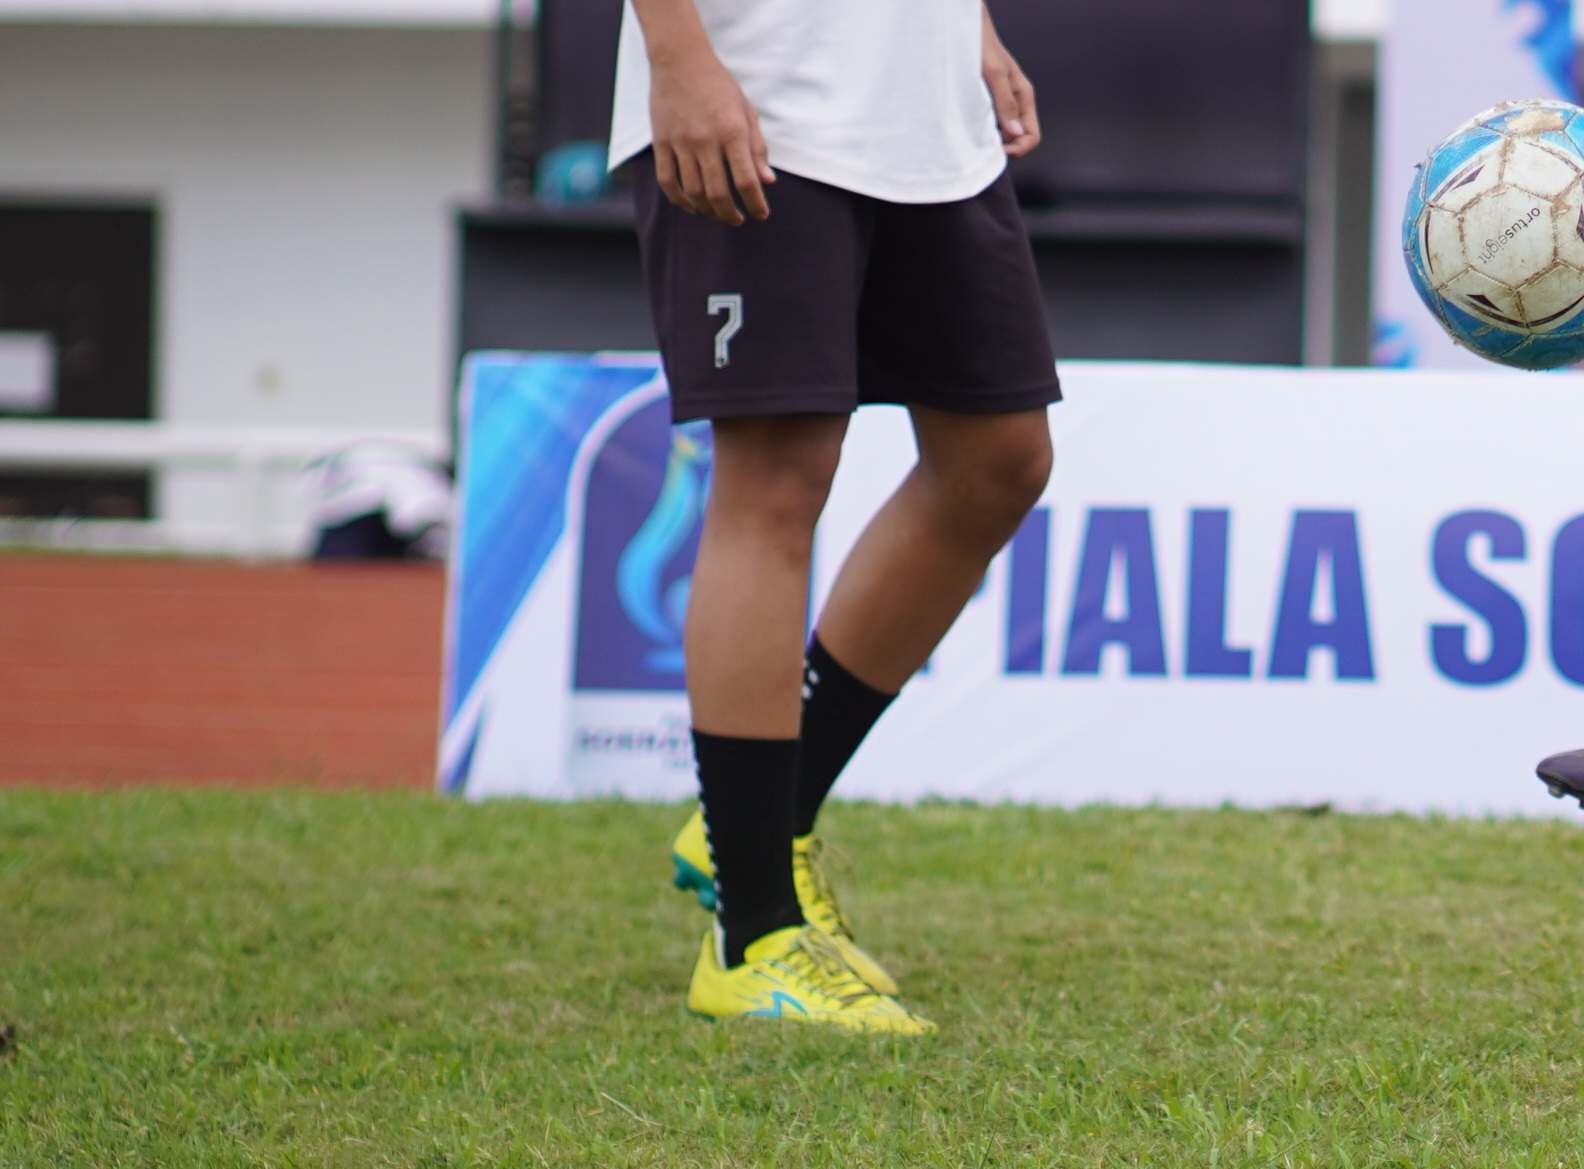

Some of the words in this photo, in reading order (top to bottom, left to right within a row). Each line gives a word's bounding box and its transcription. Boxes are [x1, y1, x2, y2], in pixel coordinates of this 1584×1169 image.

[1477, 207, 1541, 265] ortuseight
[707, 294, 743, 368] 7
[921, 505, 1379, 682] IALA
